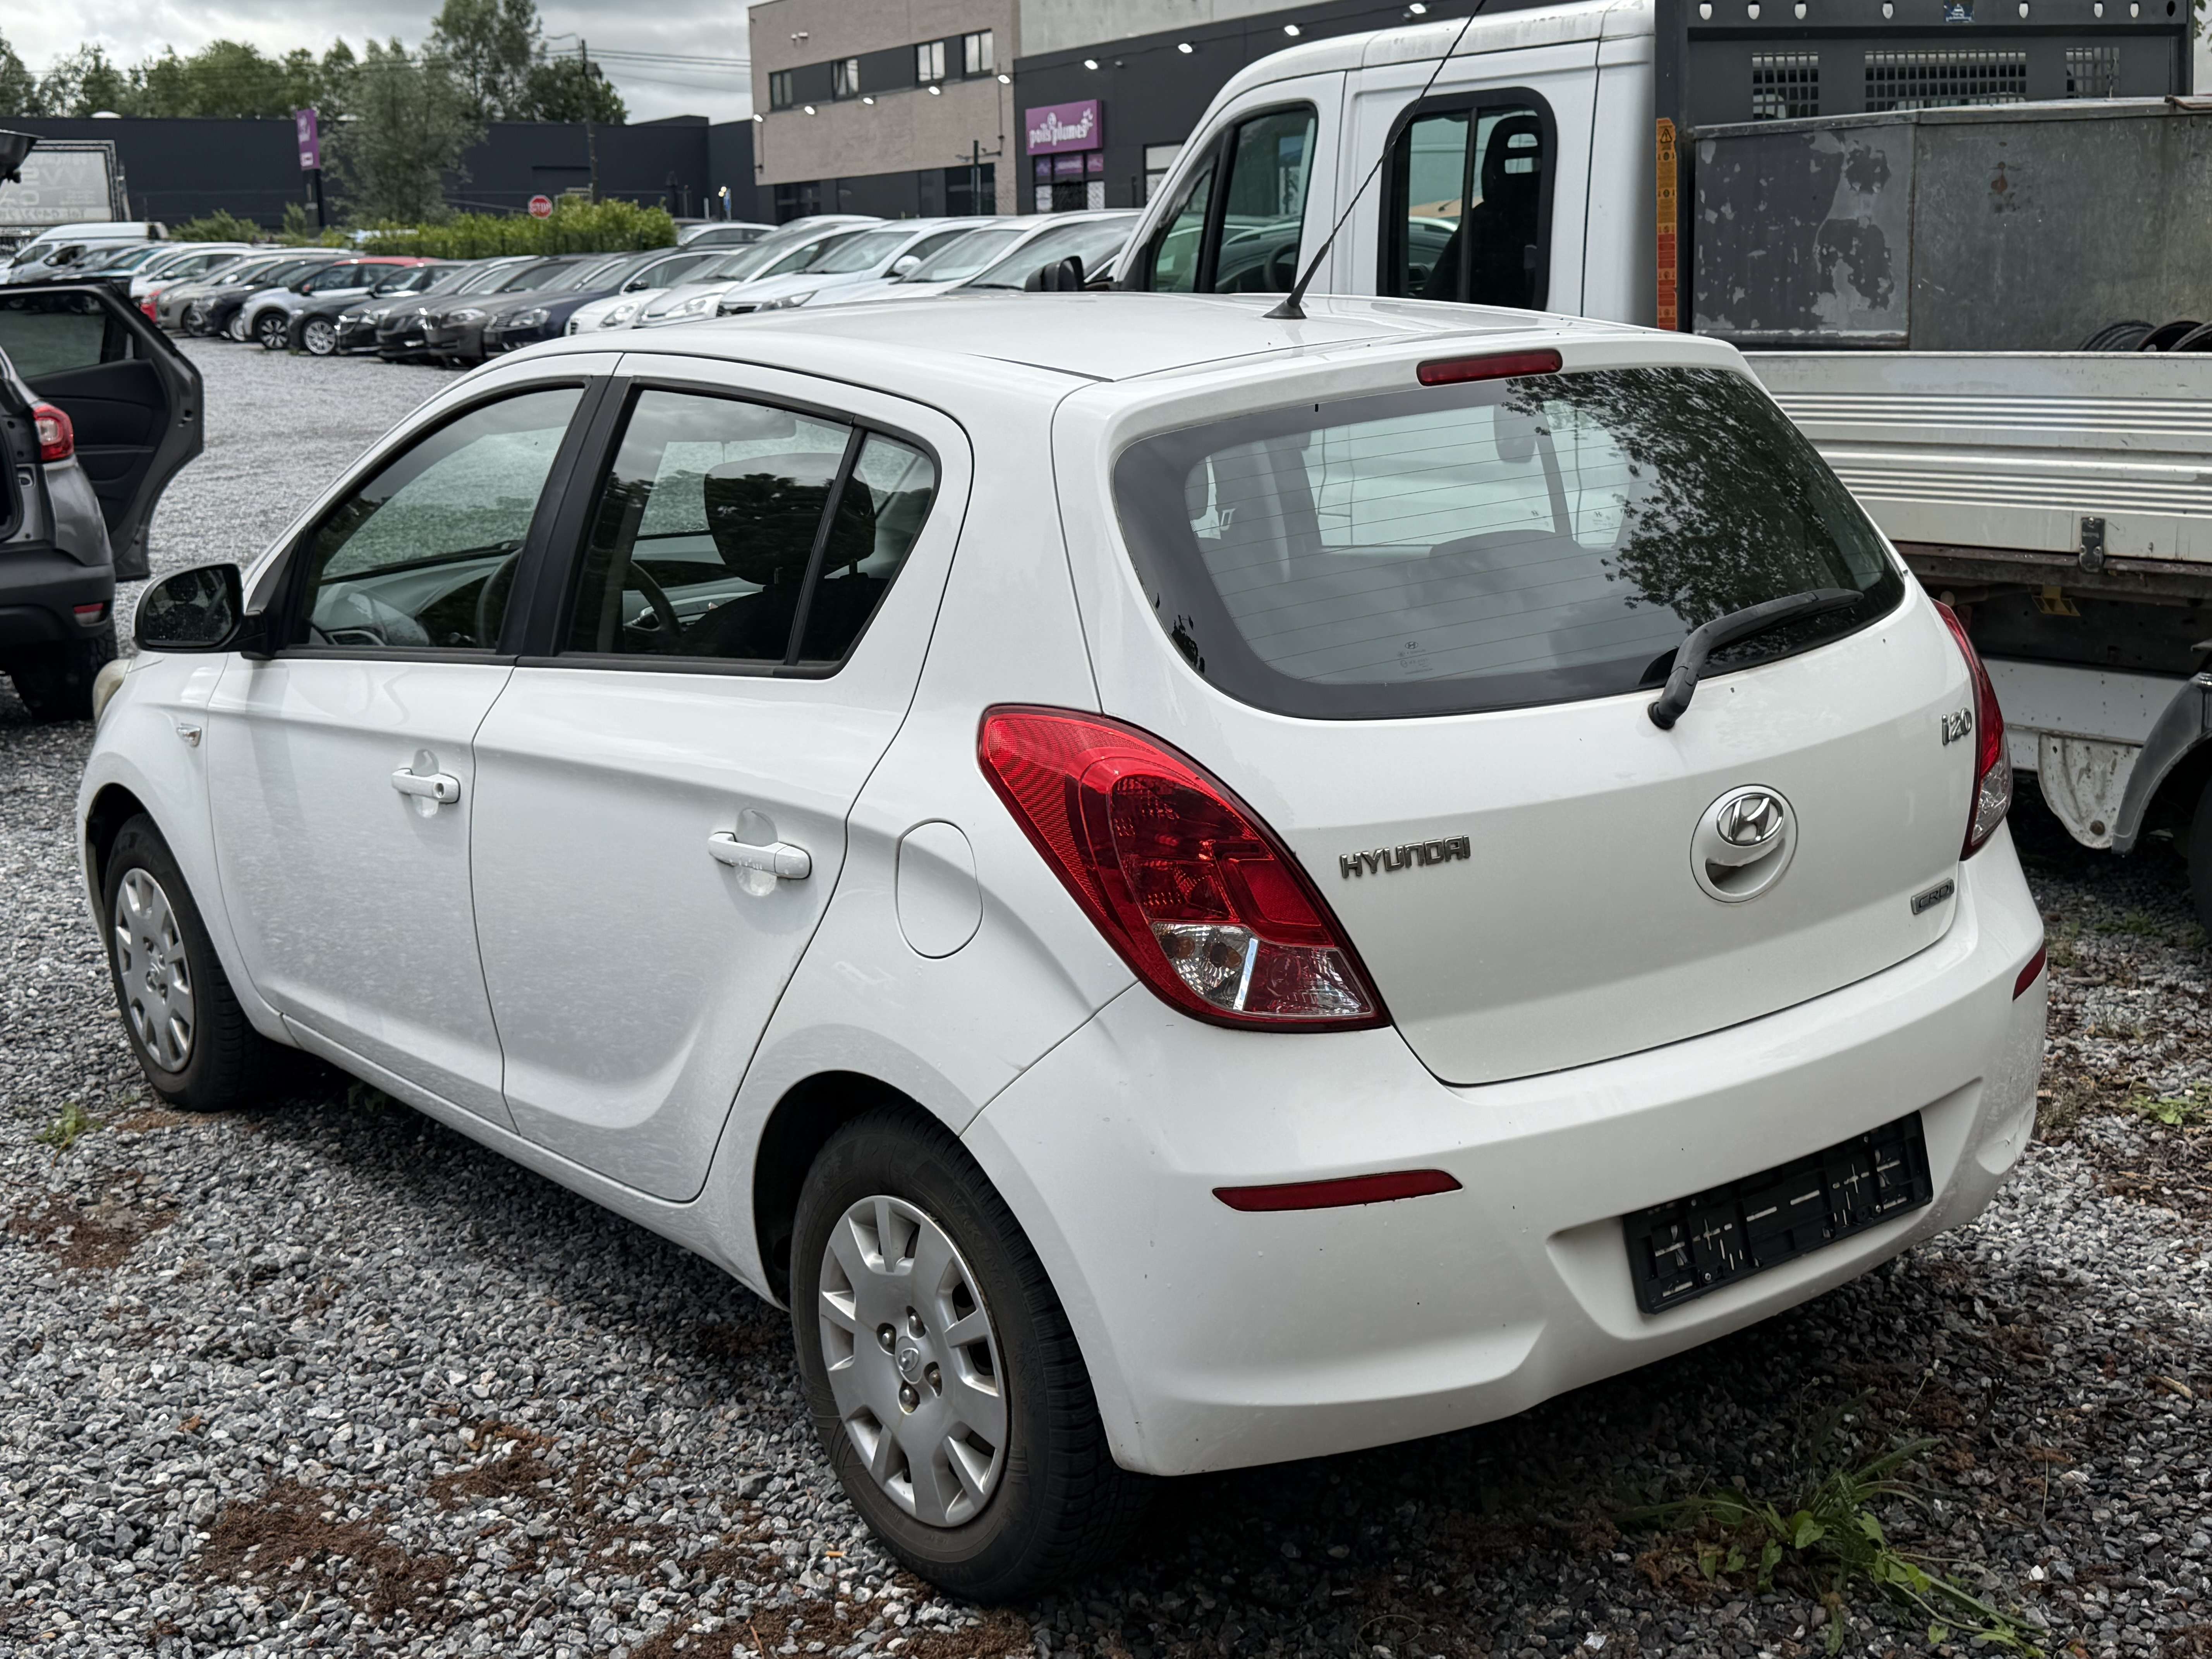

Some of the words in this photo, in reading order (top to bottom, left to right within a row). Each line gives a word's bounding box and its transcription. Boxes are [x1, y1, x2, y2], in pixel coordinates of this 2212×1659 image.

[530, 202, 551, 213] STOP
[1942, 707, 1972, 746] i20
[1339, 835, 1471, 878] HYUNDAI
[1919, 881, 1952, 908] CRDi
